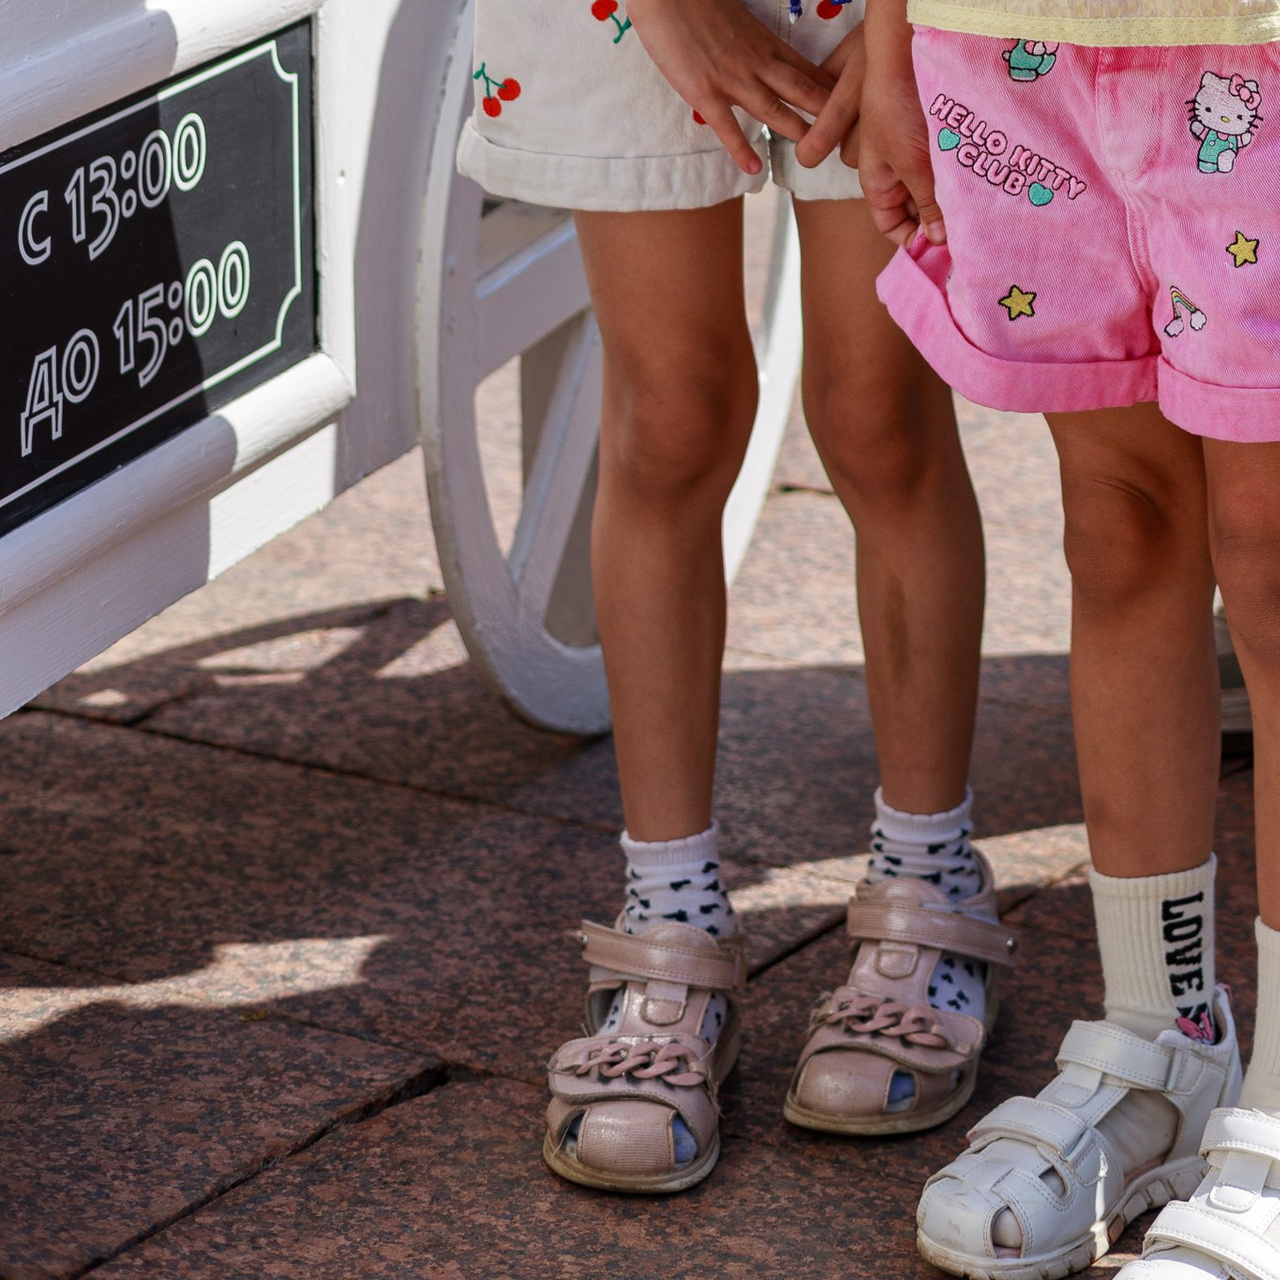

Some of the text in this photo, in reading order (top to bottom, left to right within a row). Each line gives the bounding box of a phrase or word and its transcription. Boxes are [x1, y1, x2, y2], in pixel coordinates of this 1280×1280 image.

[64, 112, 206, 260] 13:00
[929, 93, 1087, 200] HELLO KITTY
[956, 142, 1026, 196] CLUB
[113, 240, 250, 387] 15:00
[1161, 891, 1205, 997] LOVE
